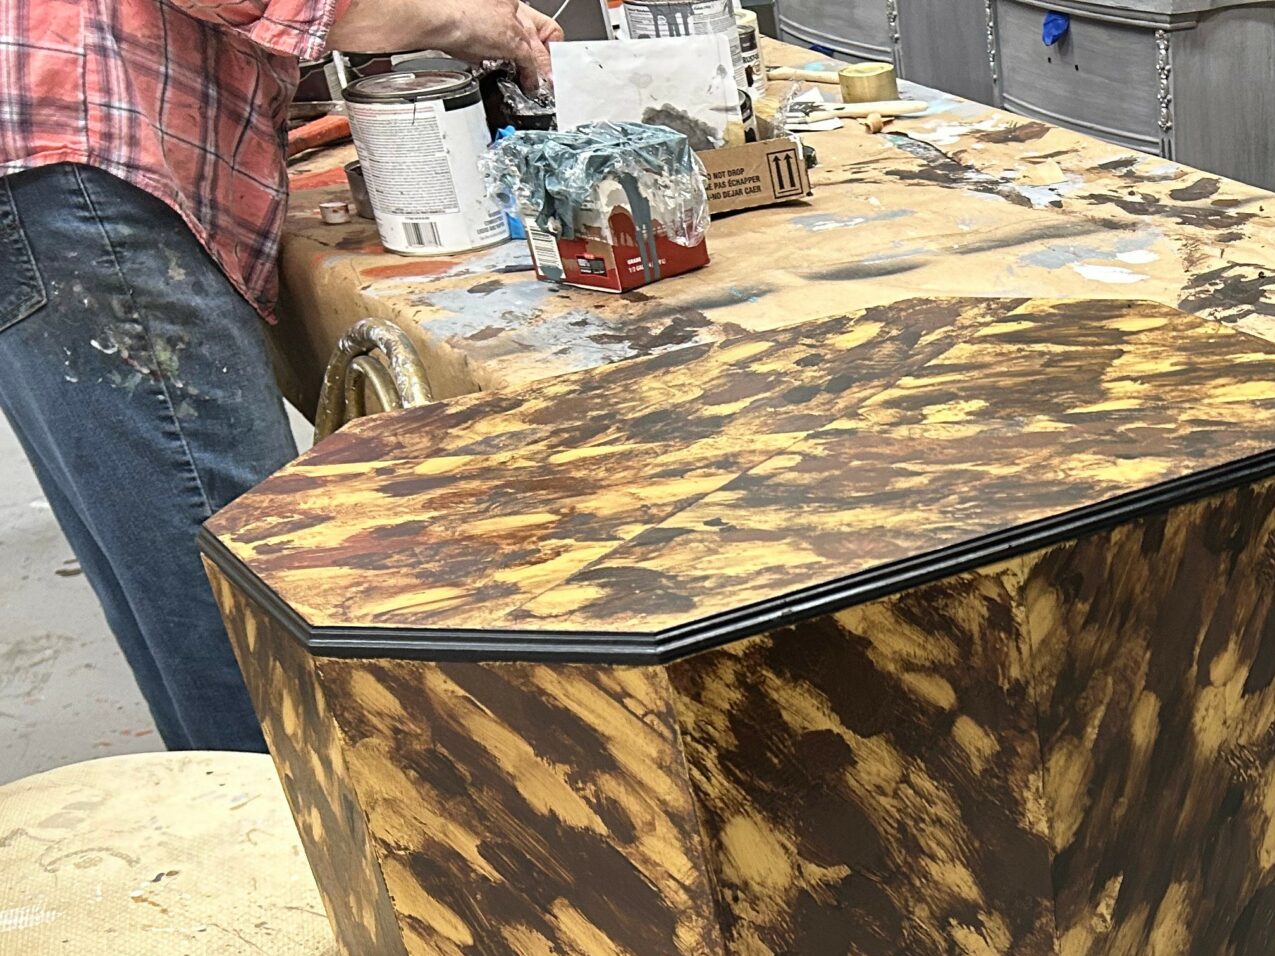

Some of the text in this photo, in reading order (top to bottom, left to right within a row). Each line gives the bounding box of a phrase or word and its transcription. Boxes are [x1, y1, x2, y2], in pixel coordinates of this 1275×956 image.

[713, 171, 726, 179] NOT
[727, 168, 745, 177] DROP
[713, 181, 726, 190] PAS
[727, 175, 760, 187] ÉCHAPPER
[722, 188, 743, 198] DEJAR
[745, 186, 761, 194] CAER
